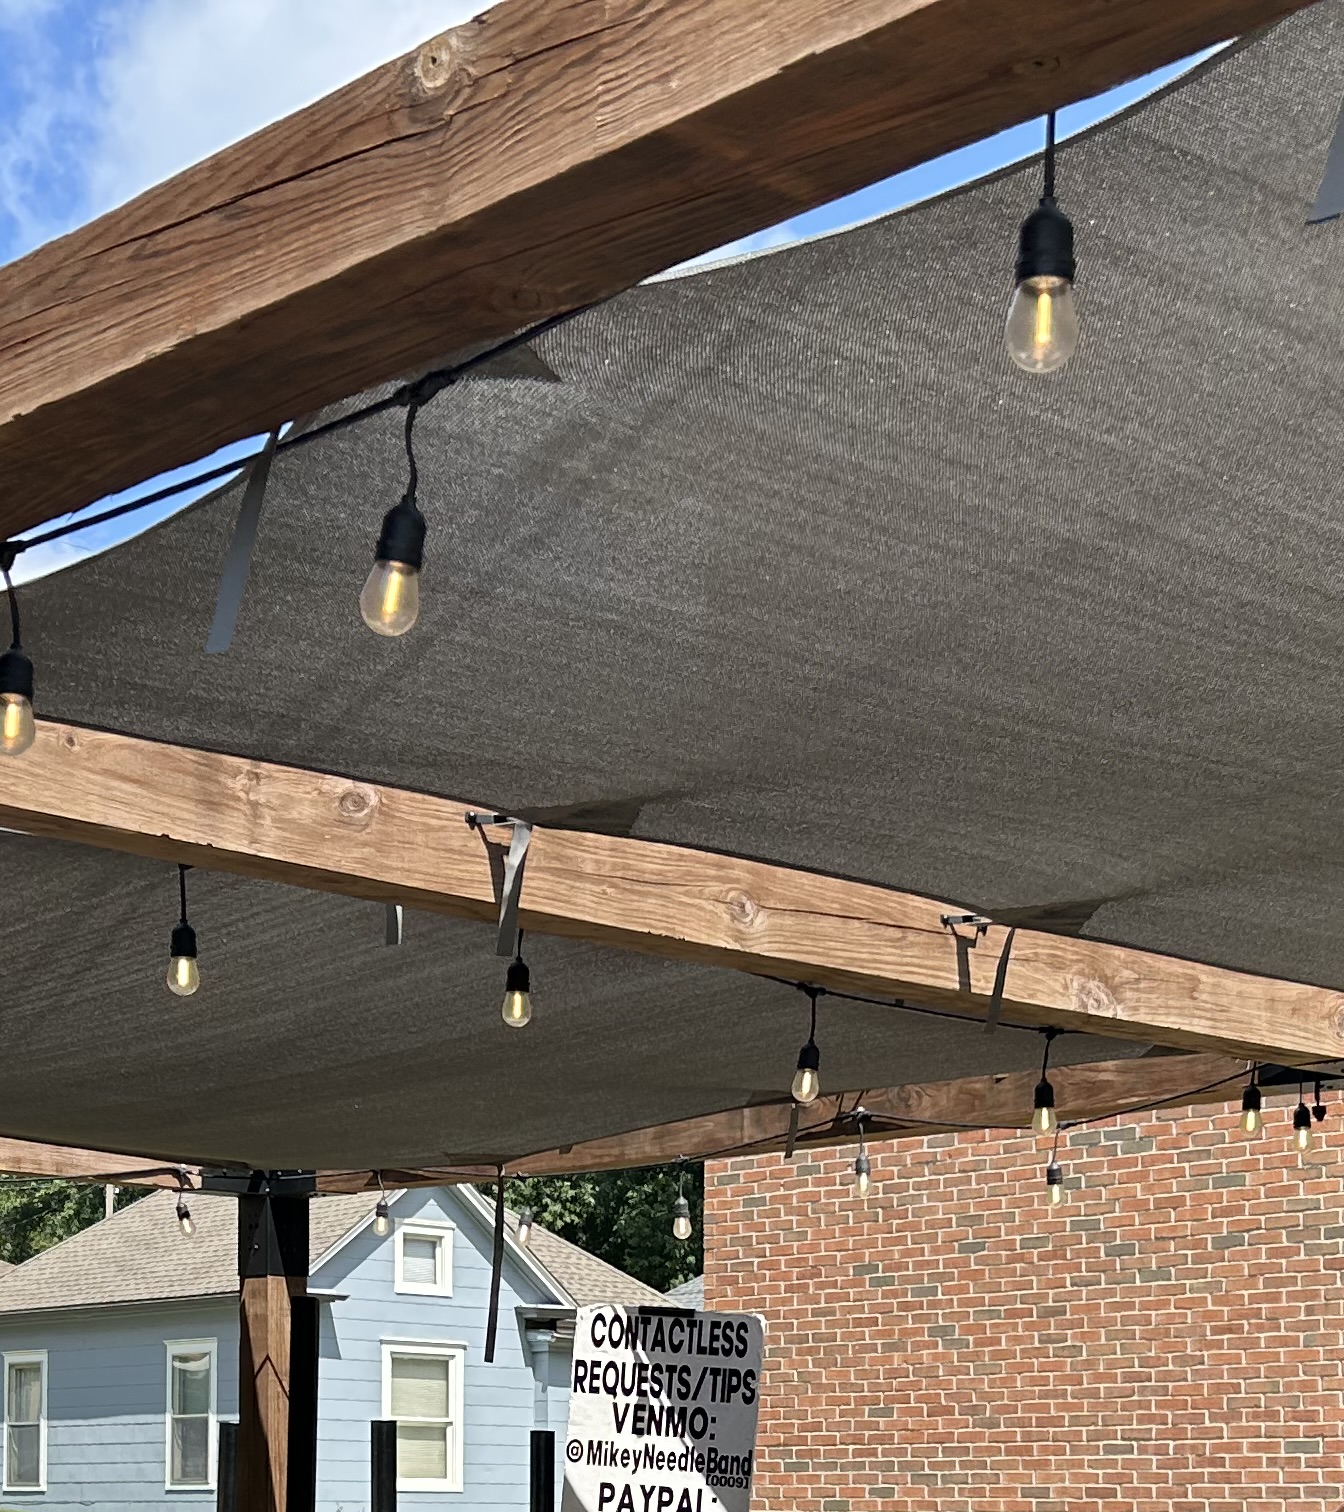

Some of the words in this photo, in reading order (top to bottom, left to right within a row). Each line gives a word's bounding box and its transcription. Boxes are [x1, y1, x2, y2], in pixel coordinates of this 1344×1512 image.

[591, 1313, 749, 1358] CONTACTLESS
[573, 1360, 756, 1405] REQUESTS/TIPS
[613, 1402, 717, 1440] VENMO:
